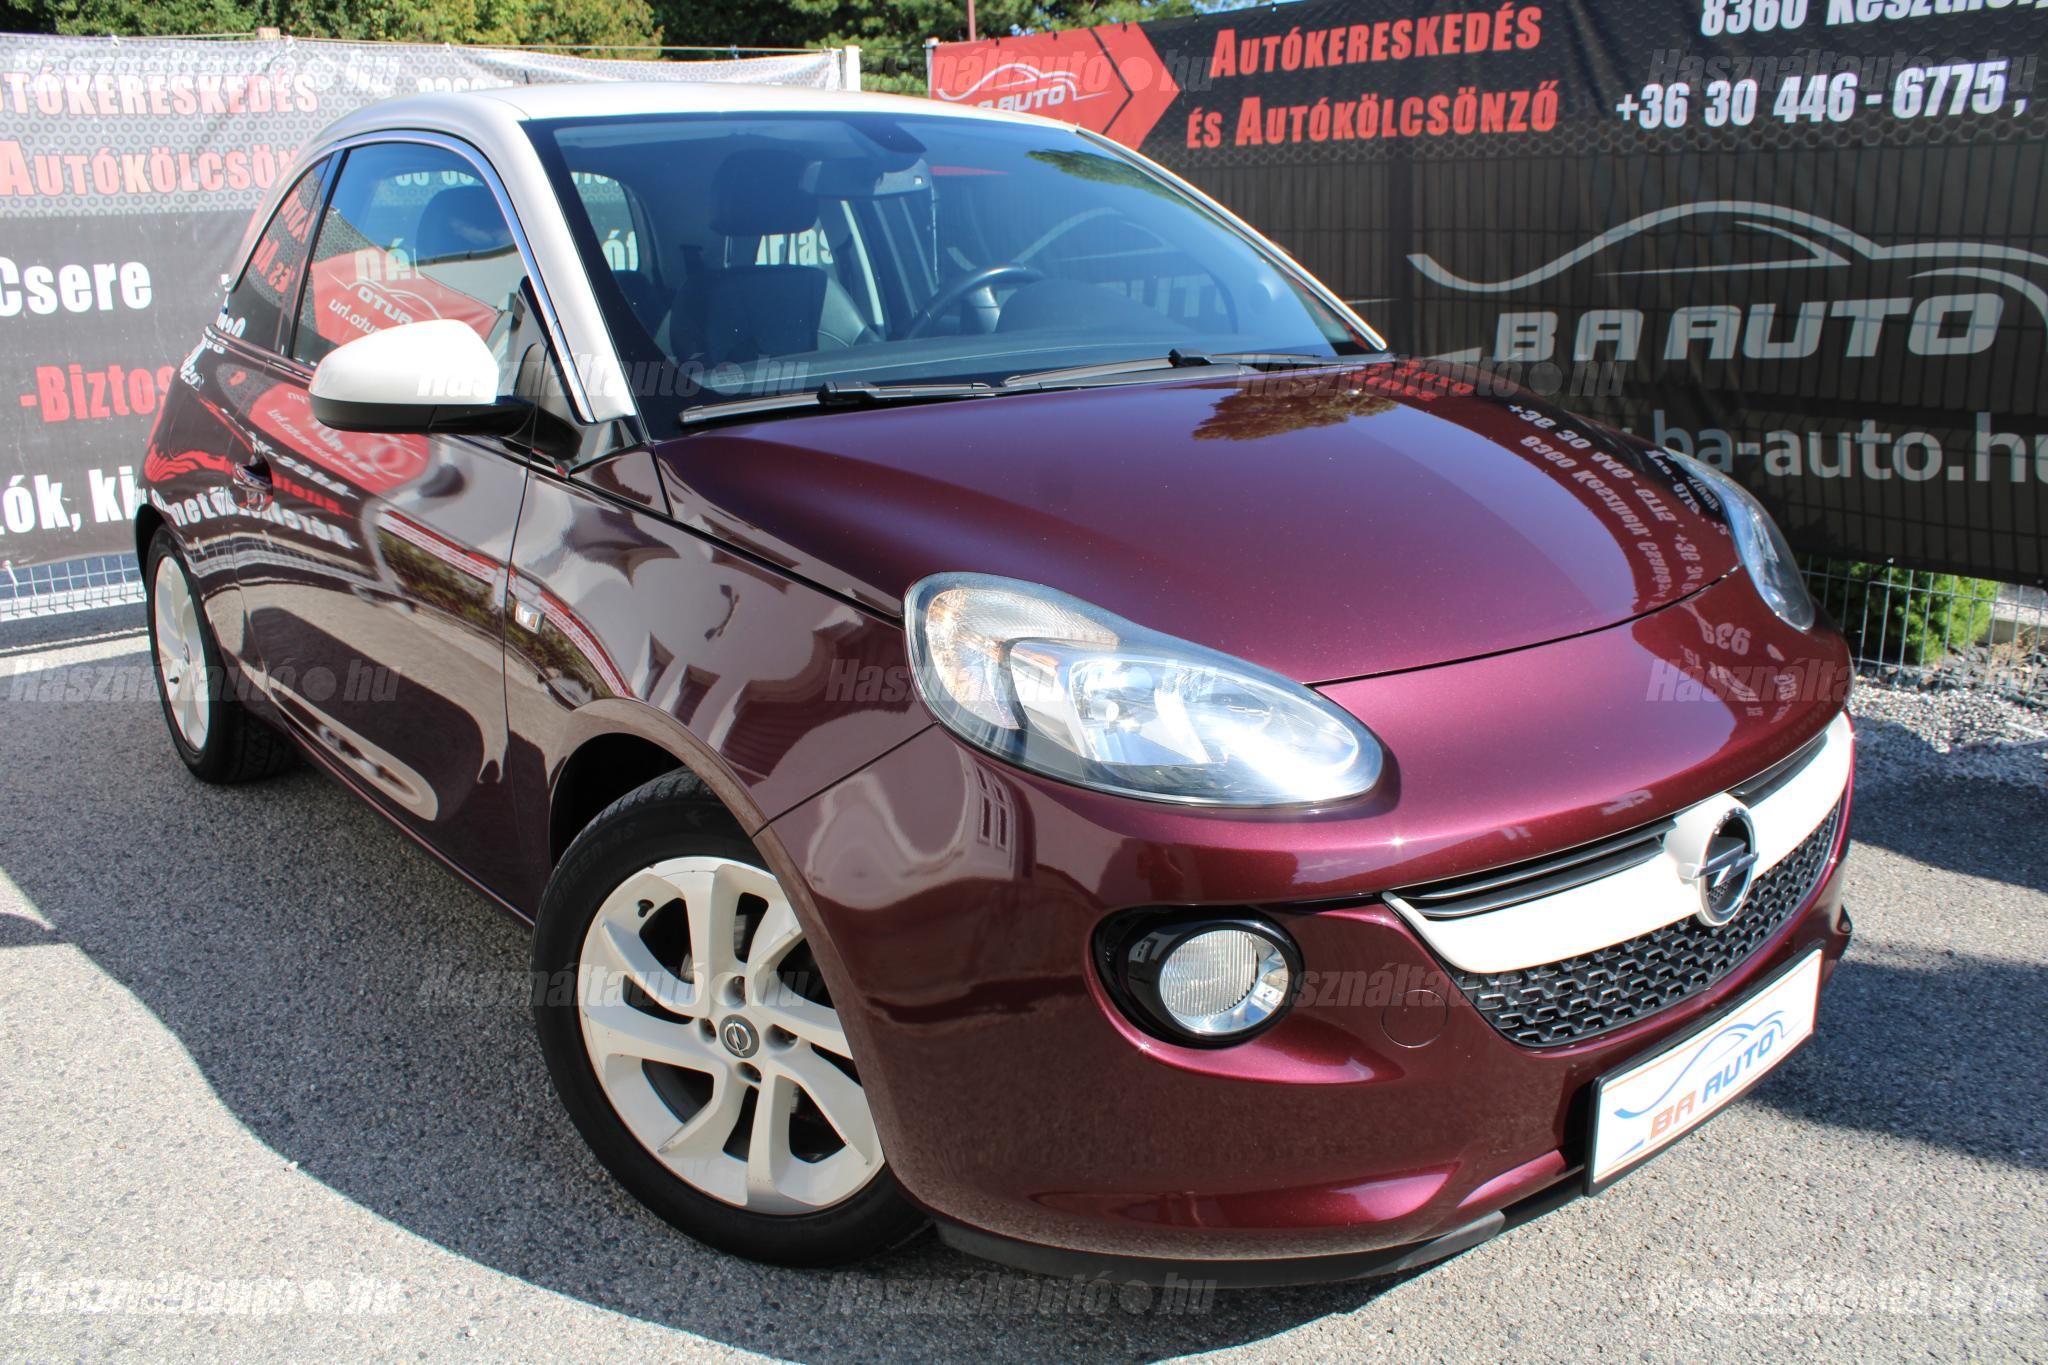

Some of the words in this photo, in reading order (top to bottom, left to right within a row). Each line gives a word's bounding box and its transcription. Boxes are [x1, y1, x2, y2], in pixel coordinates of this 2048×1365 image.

[0, 65, 320, 116] TÓKERESKEDÉS
[1616, 82, 1690, 129] +36
[1704, 79, 1757, 127] 30
[1773, 72, 1858, 124] 446
[1664, 292, 2005, 361] AUTO
[0, 474, 82, 533] ók,
[1649, 1089, 1697, 1140] BA
[1702, 1027, 1775, 1105] AUTO
